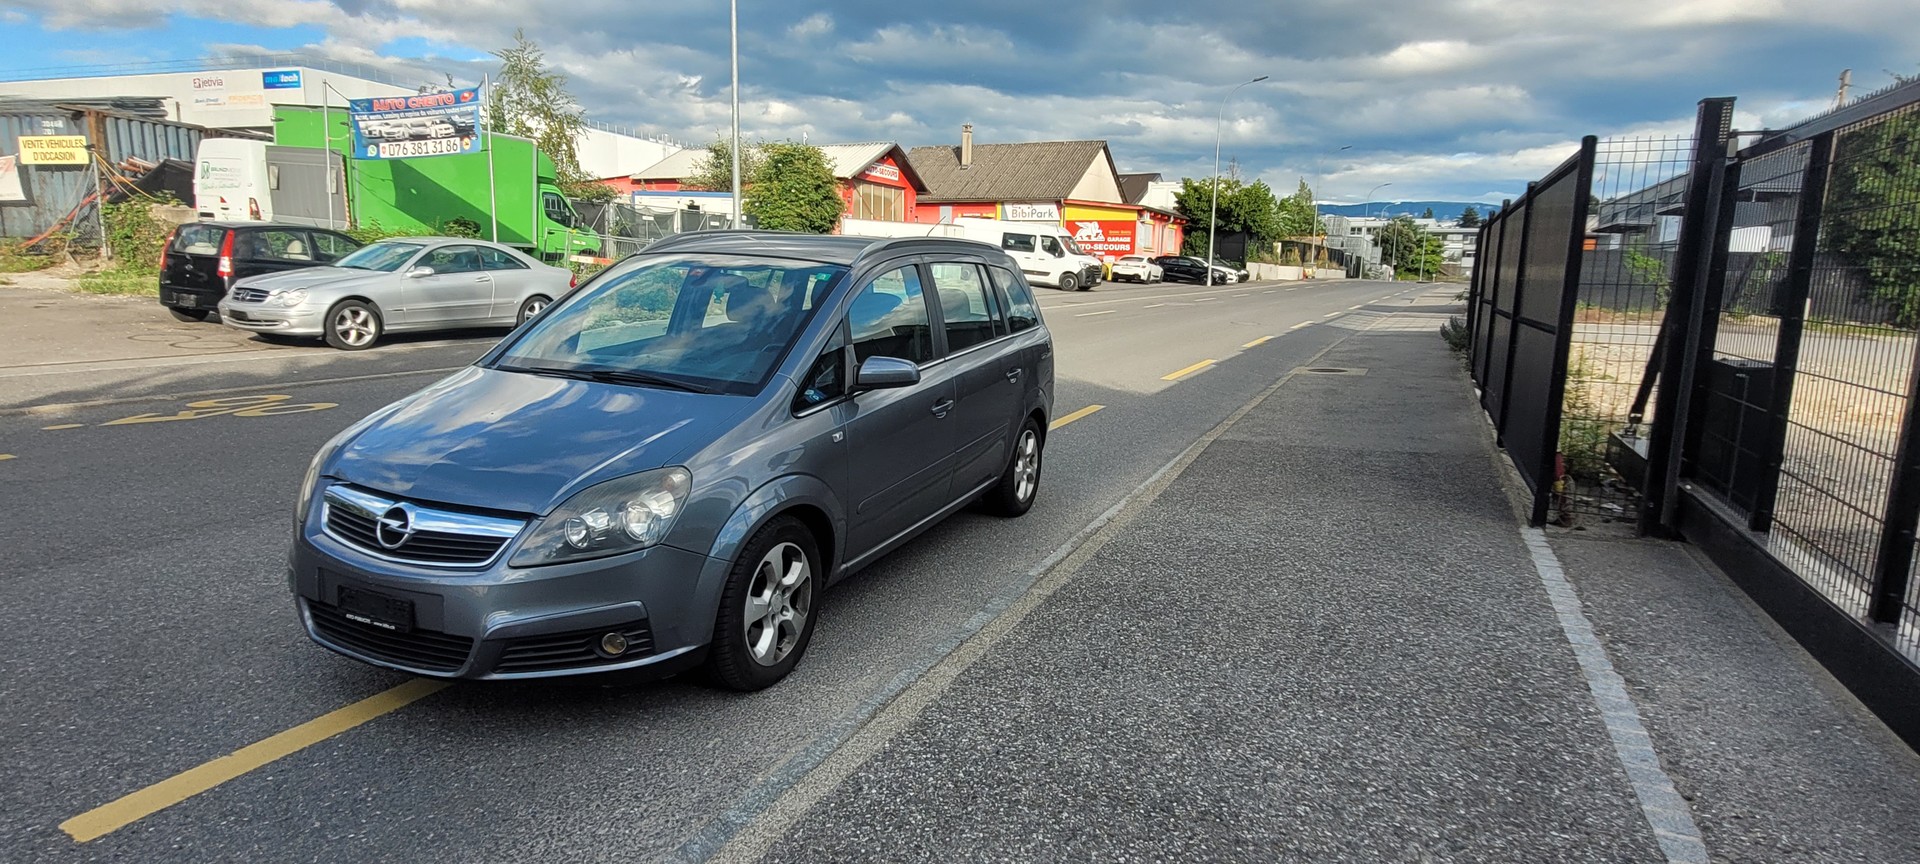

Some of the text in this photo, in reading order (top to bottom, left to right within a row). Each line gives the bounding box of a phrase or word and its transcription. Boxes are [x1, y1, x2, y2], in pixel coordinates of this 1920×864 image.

[373, 98, 406, 112] AUTO
[22, 139, 44, 149] VENTE
[388, 139, 458, 156] 076 381 31 86
[33, 151, 76, 161] D'OCCASION
[1011, 208, 1054, 218] BibiPark
